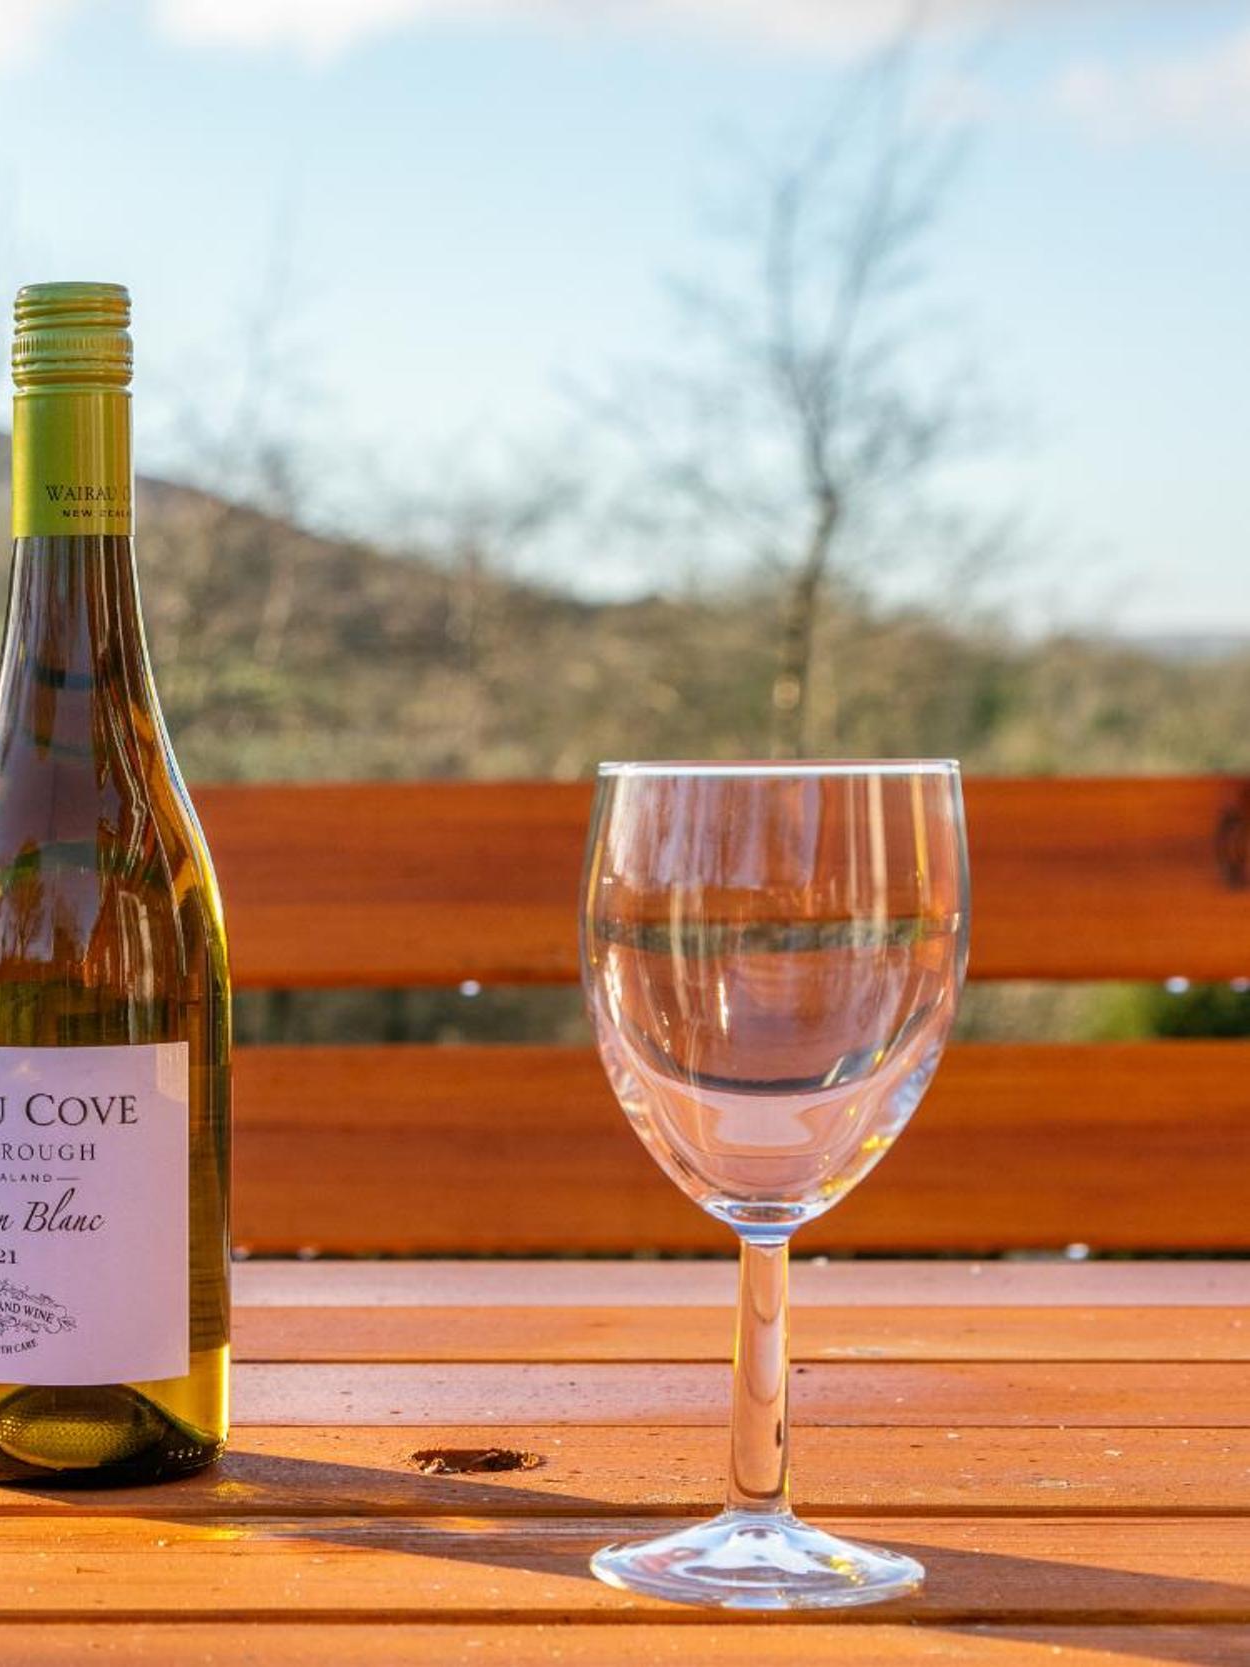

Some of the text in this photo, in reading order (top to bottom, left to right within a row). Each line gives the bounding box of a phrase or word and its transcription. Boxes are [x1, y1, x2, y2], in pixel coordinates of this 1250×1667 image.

[62, 509, 92, 518] NEW
[25, 1093, 138, 1126] COVE
[23, 1187, 105, 1232] Blanc
[23, 1304, 55, 1324] WINE
